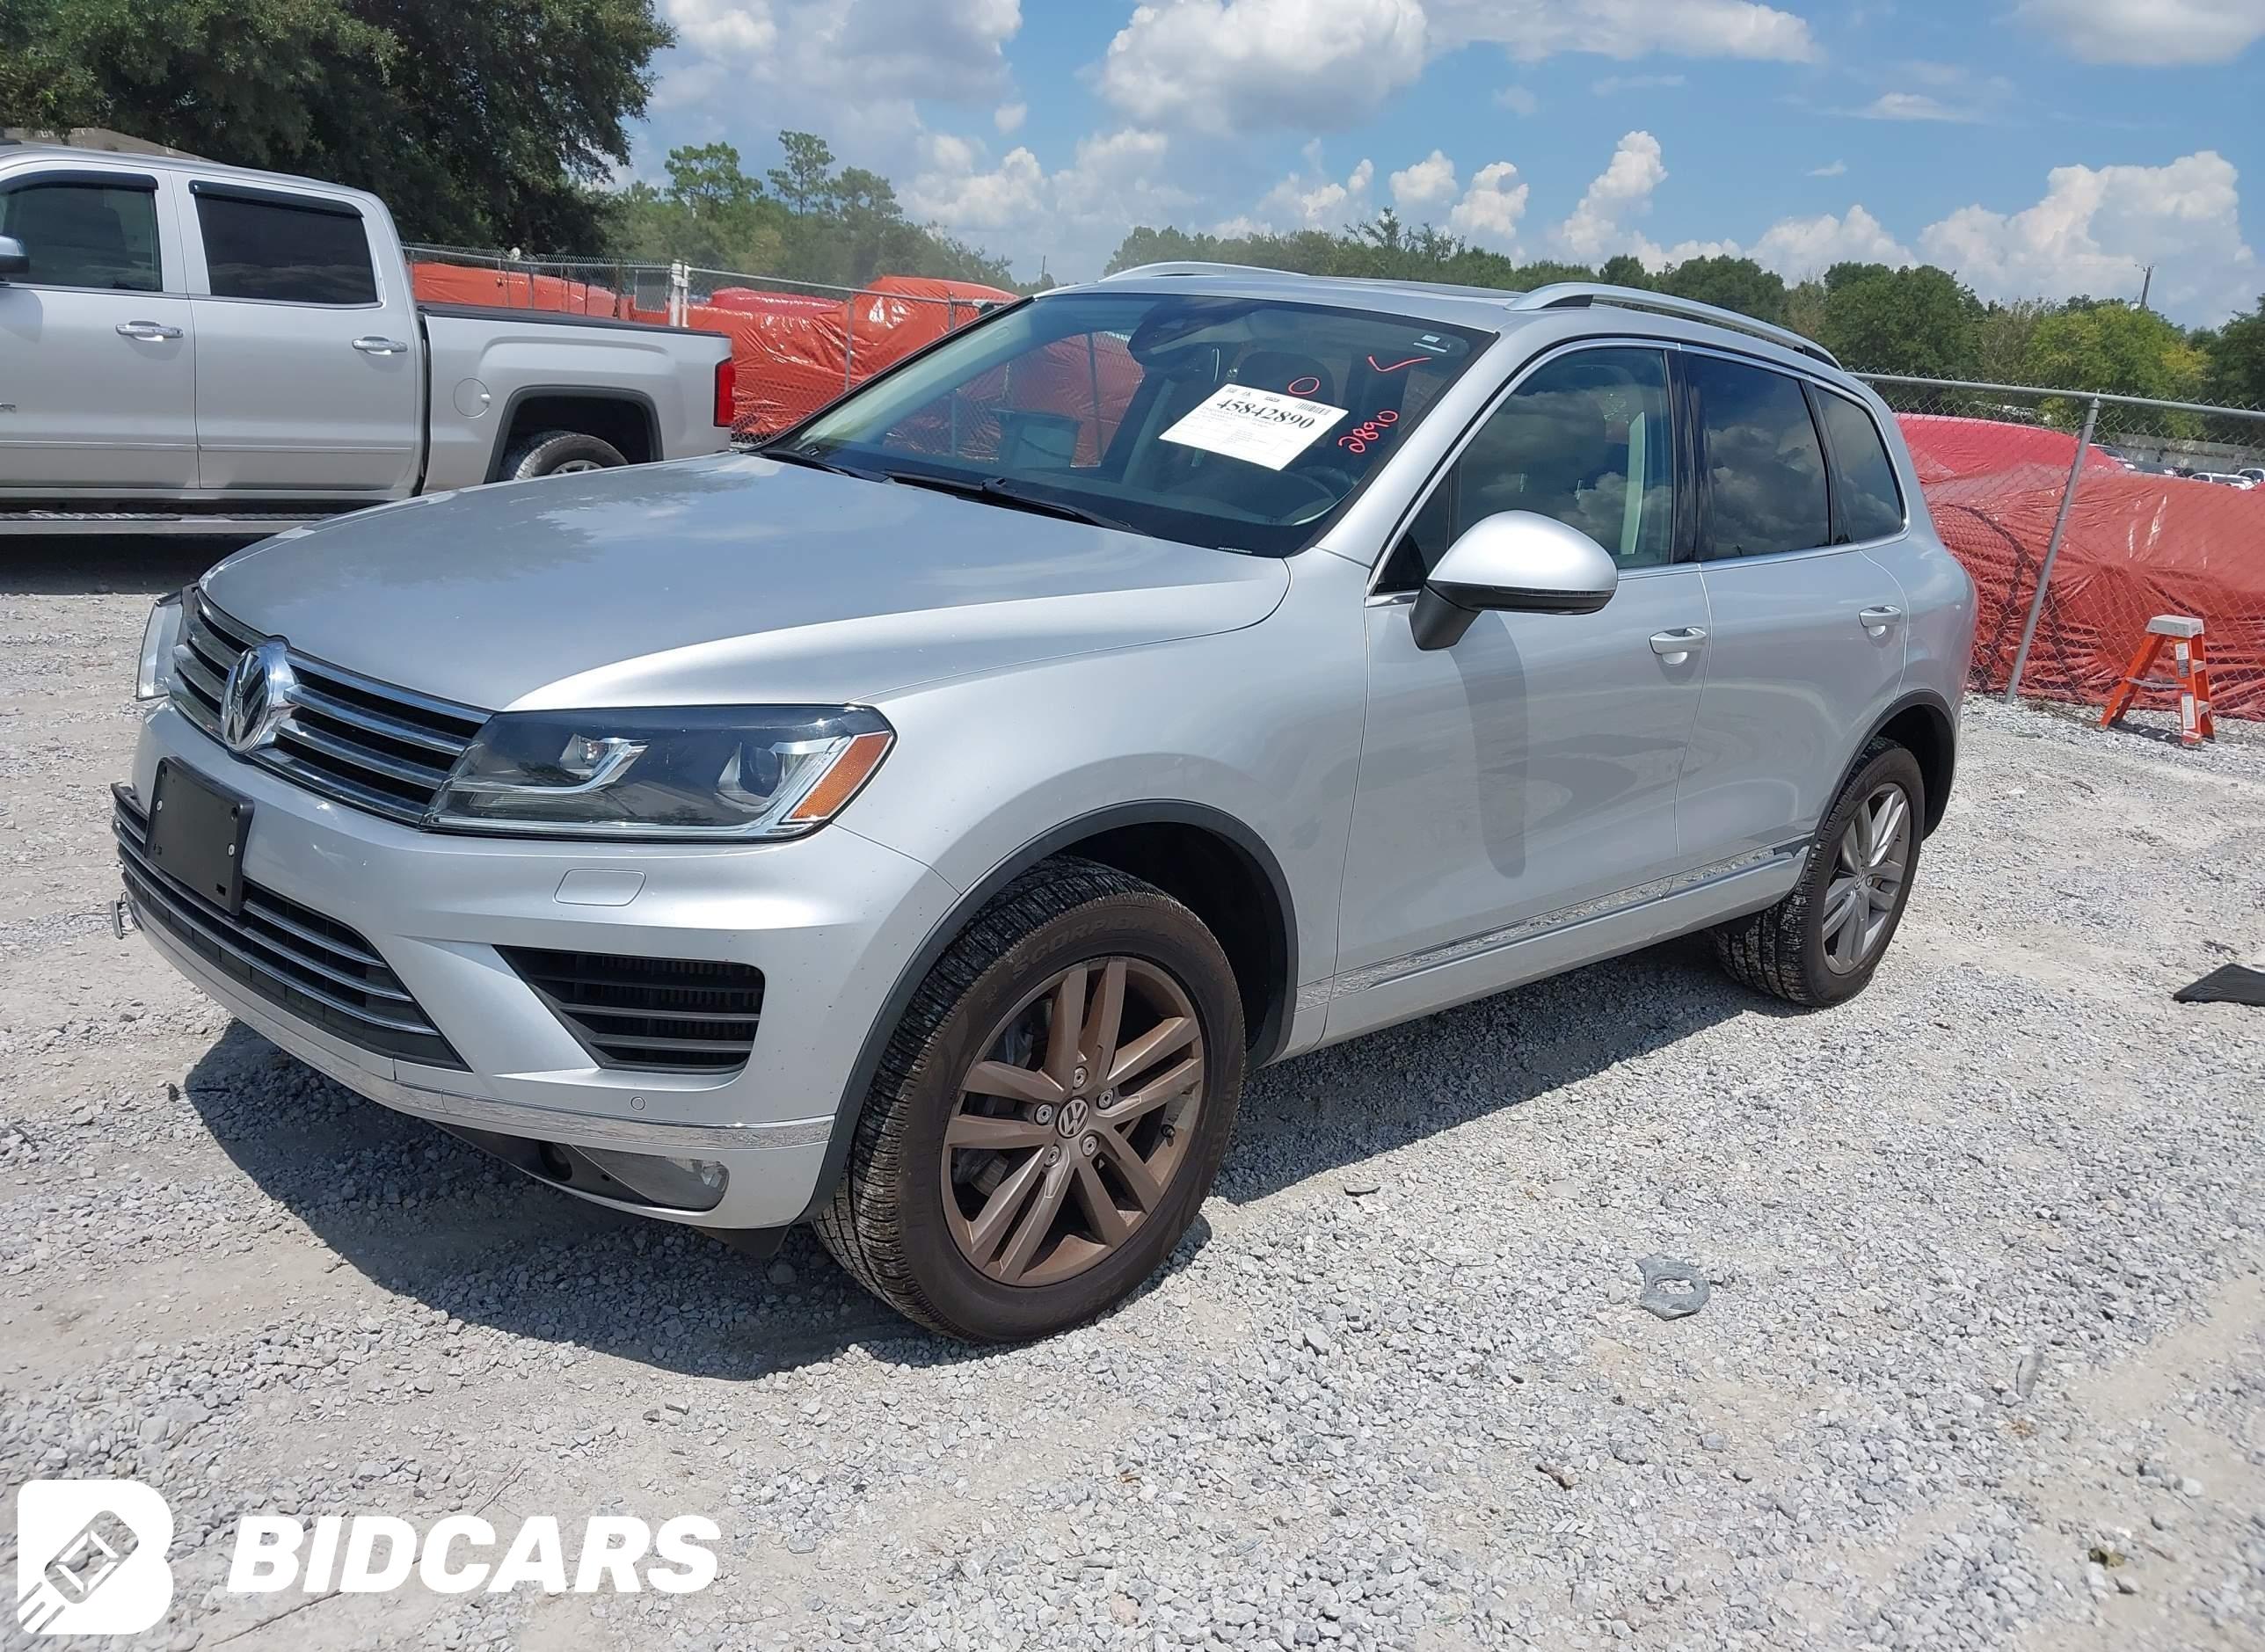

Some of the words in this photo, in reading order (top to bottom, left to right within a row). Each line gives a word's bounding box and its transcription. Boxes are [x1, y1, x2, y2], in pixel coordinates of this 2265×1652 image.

[1217, 399, 1315, 429] 45842890
[1338, 410, 1399, 454] 2890
[1058, 1099, 1089, 1137] VW
